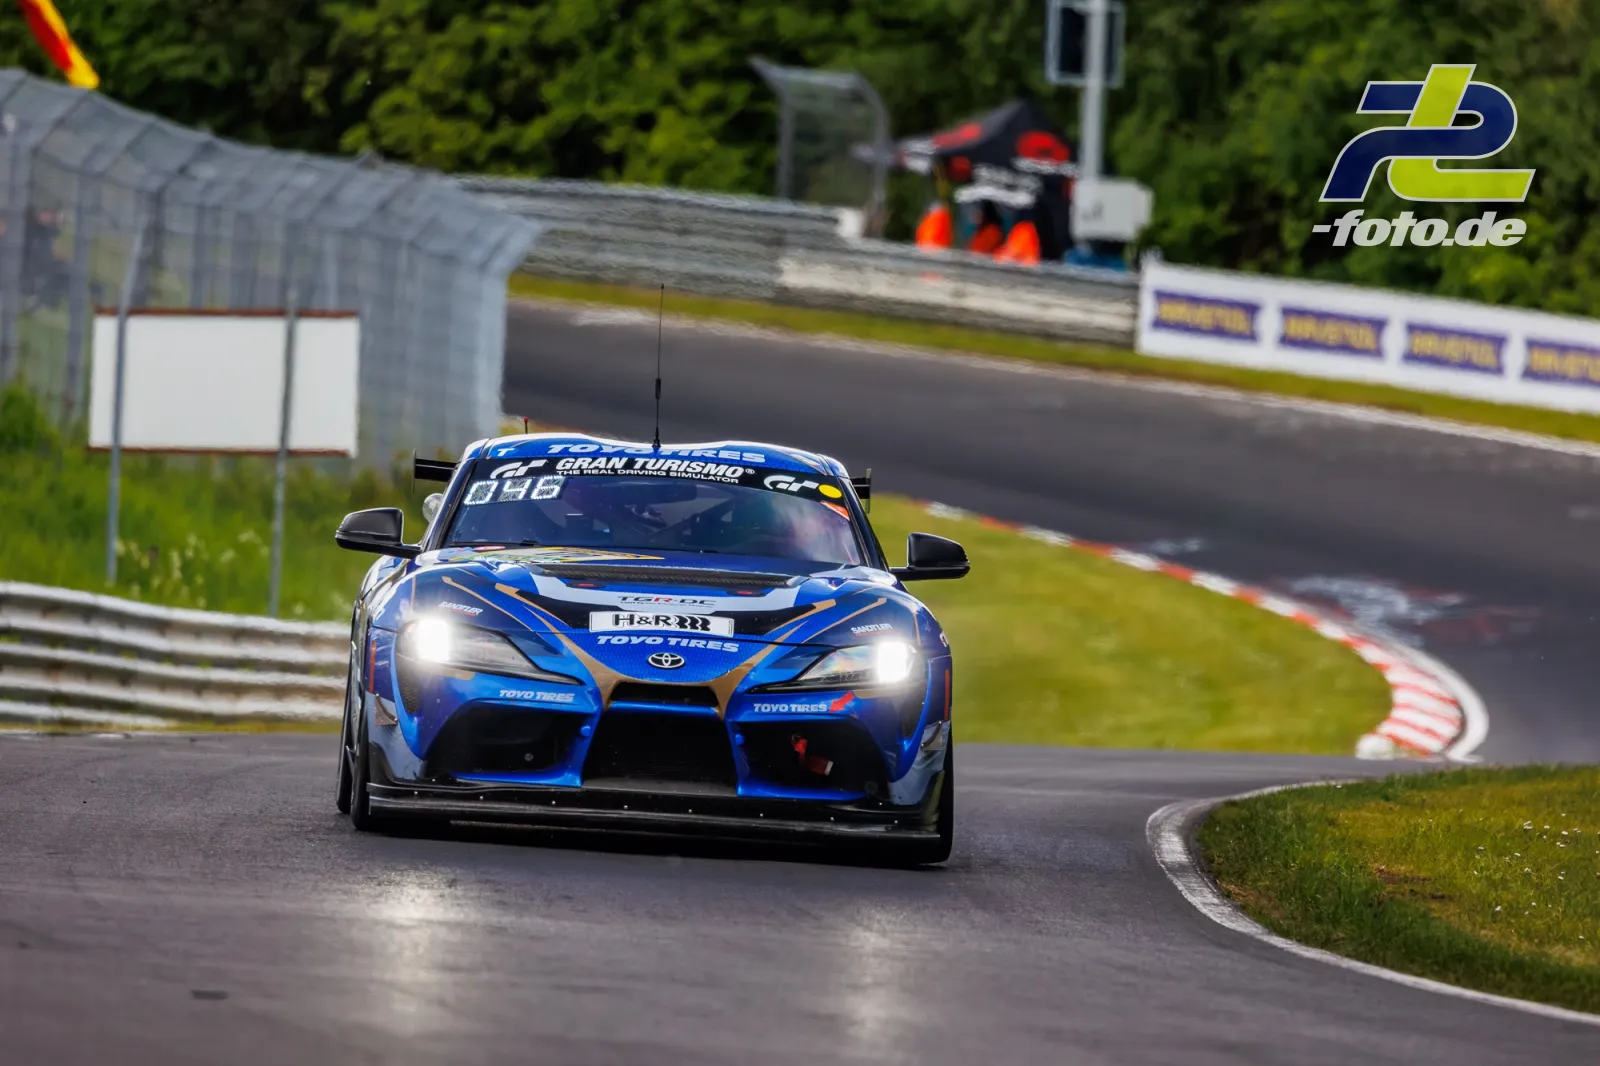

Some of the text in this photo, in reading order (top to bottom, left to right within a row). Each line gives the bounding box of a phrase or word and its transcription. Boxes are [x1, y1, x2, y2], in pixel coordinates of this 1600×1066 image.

[547, 443, 766, 463] TOYO TIRES
[555, 457, 629, 470] GRAN
[669, 471, 740, 484] SIMULATOR
[463, 475, 567, 505] 046
[597, 635, 740, 653] TOYO TIRES
[499, 689, 576, 703] TOYO TIRES
[753, 703, 828, 713] TOYO TIRES
